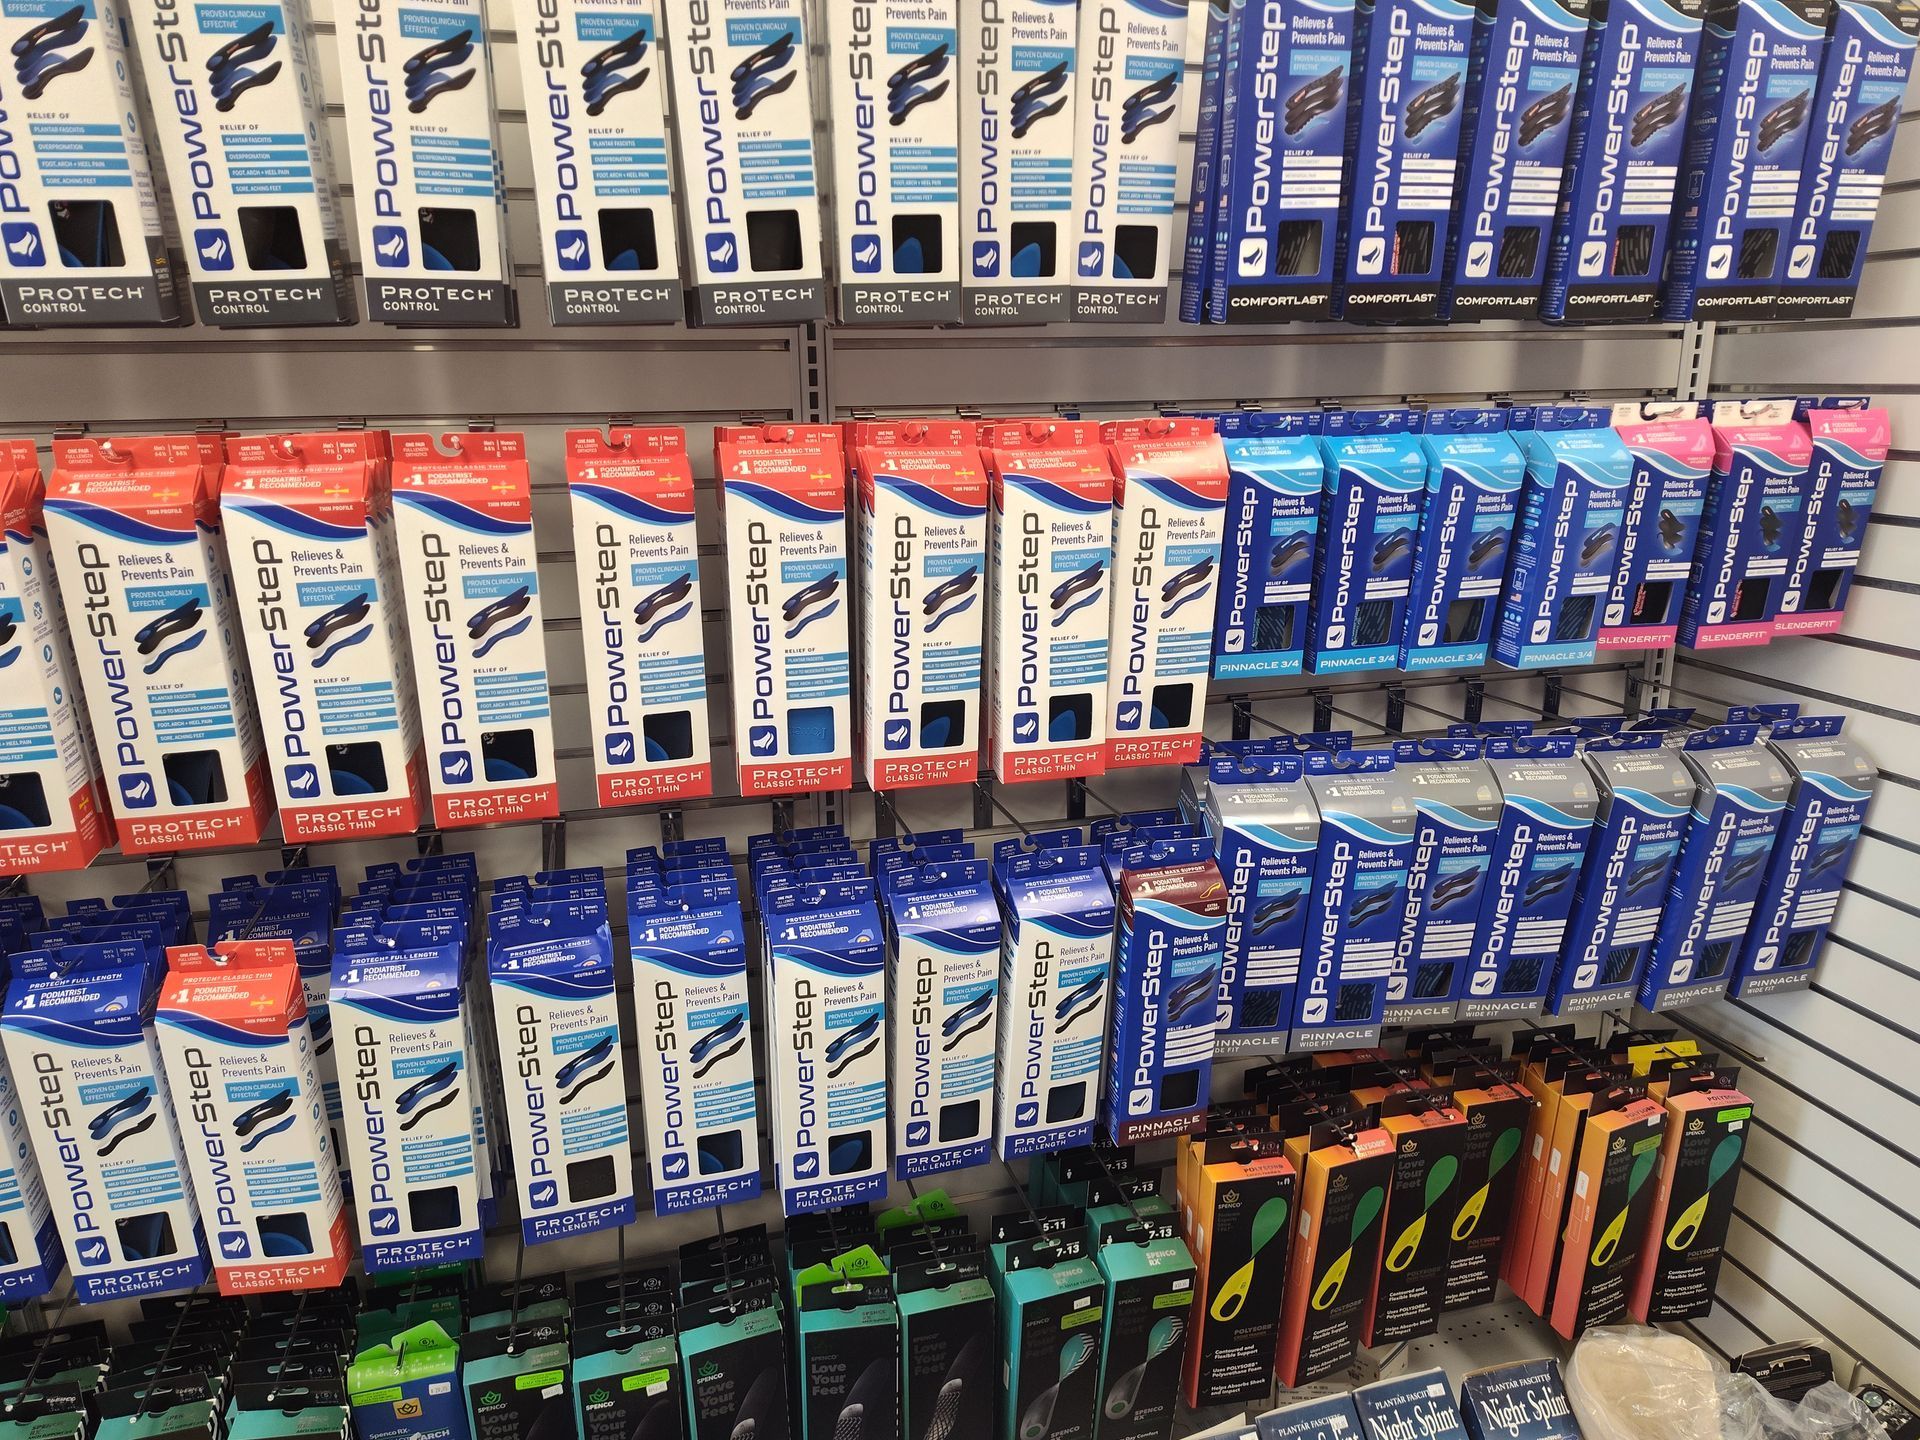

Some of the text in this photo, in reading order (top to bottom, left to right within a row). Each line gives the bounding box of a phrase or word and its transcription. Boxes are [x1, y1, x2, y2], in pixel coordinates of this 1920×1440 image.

[1012, 12, 1054, 23] Relieves &
[1293, 16, 1333, 29] Relieves &
[1012, 28, 1067, 40] Prevents Pain
[1292, 32, 1345, 44] Prevents Pain
[1231, 295, 1325, 307] COMFORTLAST
[1348, 294, 1434, 303] COMFORTLAST
[1569, 295, 1651, 304] COMFORTLAST
[1697, 297, 1774, 306] COMFORTLAST
[1777, 297, 1851, 305] COMFORTLAST
[22, 302, 86, 314] CONTROL
[567, 304, 620, 313] CONTROL
[856, 304, 903, 313] CONTROL
[754, 466, 806, 474] RECOMMENDED
[780, 531, 823, 542] Relieves &
[780, 544, 837, 556] Prevents Pain
[118, 554, 174, 566] Relieves &
[122, 568, 194, 581] Prevents Pain
[1775, 621, 1834, 631] SLENDERFIT
[1598, 634, 1669, 643] SLENDERFIT
[1701, 632, 1764, 642] SLENDERFIT
[1411, 653, 1483, 666] PINNACLE 3/4
[1220, 660, 1299, 672] PINNACLE 3/4
[1015, 764, 1076, 775] CLASSIC THIN
[449, 805, 523, 818] CLASSIC THIN
[134, 832, 216, 845] CLASSIC THIN
[1359, 850, 1393, 859] Relieves &
[1358, 858, 1402, 869] Prevents Pain
[1153, 878, 1185, 887] PODIATRIST
[1154, 882, 1197, 892] RECOMMENDED
[800, 923, 835, 931] PODIATRIST
[800, 927, 848, 939] RECOMMENDED
[1749, 974, 1808, 987] PINNACLE
[41, 988, 87, 999] PODIATRIST
[39, 994, 100, 1007] RECOMMENDED
[1468, 1002, 1537, 1011] PINNACLE
[1301, 1030, 1373, 1041] PINNACLE
[1321, 1039, 1333, 1047] FIT
[1129, 1115, 1200, 1133] PINNACLE
[1128, 1125, 1188, 1140] MAXX SUPPORT
[1106, 1161, 1127, 1171] 7-13
[1132, 1183, 1153, 1193] 7-13
[692, 1193, 728, 1204] LENGTH
[1043, 1221, 1066, 1231] 5-11
[1149, 1229, 1172, 1239] 7-13
[1056, 1246, 1080, 1257] 7-13
[91, 1280, 163, 1296] FULL LENGTH
[232, 1277, 302, 1288] CLASSIC THIN
[812, 1363, 846, 1372] Love
[697, 1373, 723, 1384] SPENCO
[812, 1374, 844, 1384] Your
[812, 1385, 844, 1396] Feet
[1486, 1381, 1519, 1393] PLANTAR
[478, 1403, 506, 1412] SPENCO
[586, 1402, 613, 1410] SPENCO
[1481, 1384, 1570, 1437] Night Splint
[1414, 1401, 1459, 1440] Splint
[370, 1430, 396, 1439] Spenco
